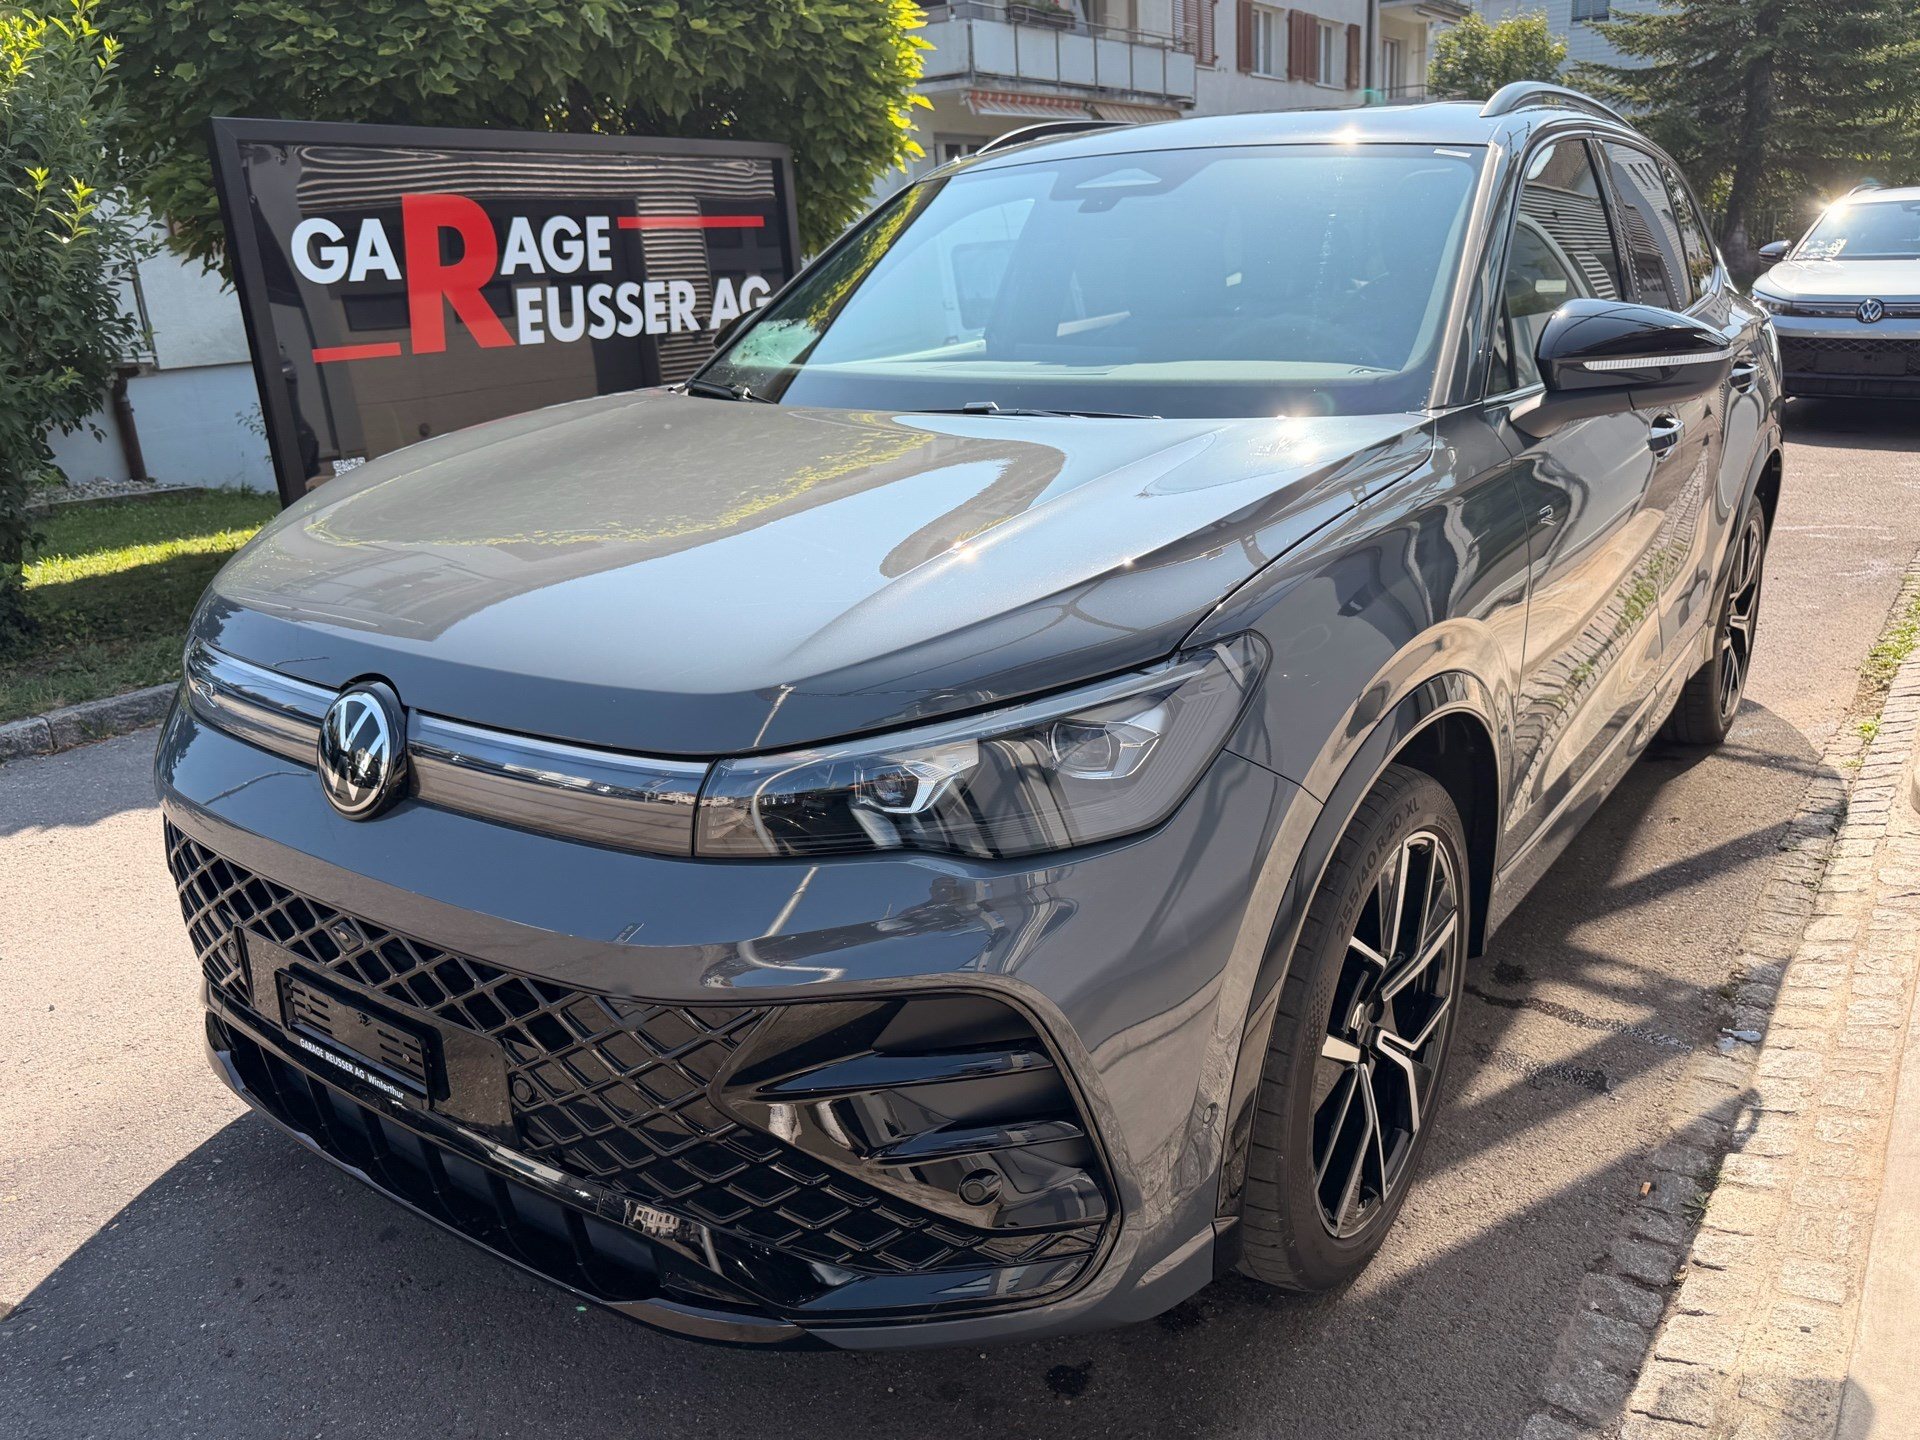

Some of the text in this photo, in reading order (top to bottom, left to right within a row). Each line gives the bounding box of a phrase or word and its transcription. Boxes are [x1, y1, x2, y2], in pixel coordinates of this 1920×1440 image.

[708, 276, 773, 329] AG
[1405, 797, 1420, 819] XL
[300, 1038, 405, 1100] GARAGE REUSSER AG Winterthur
